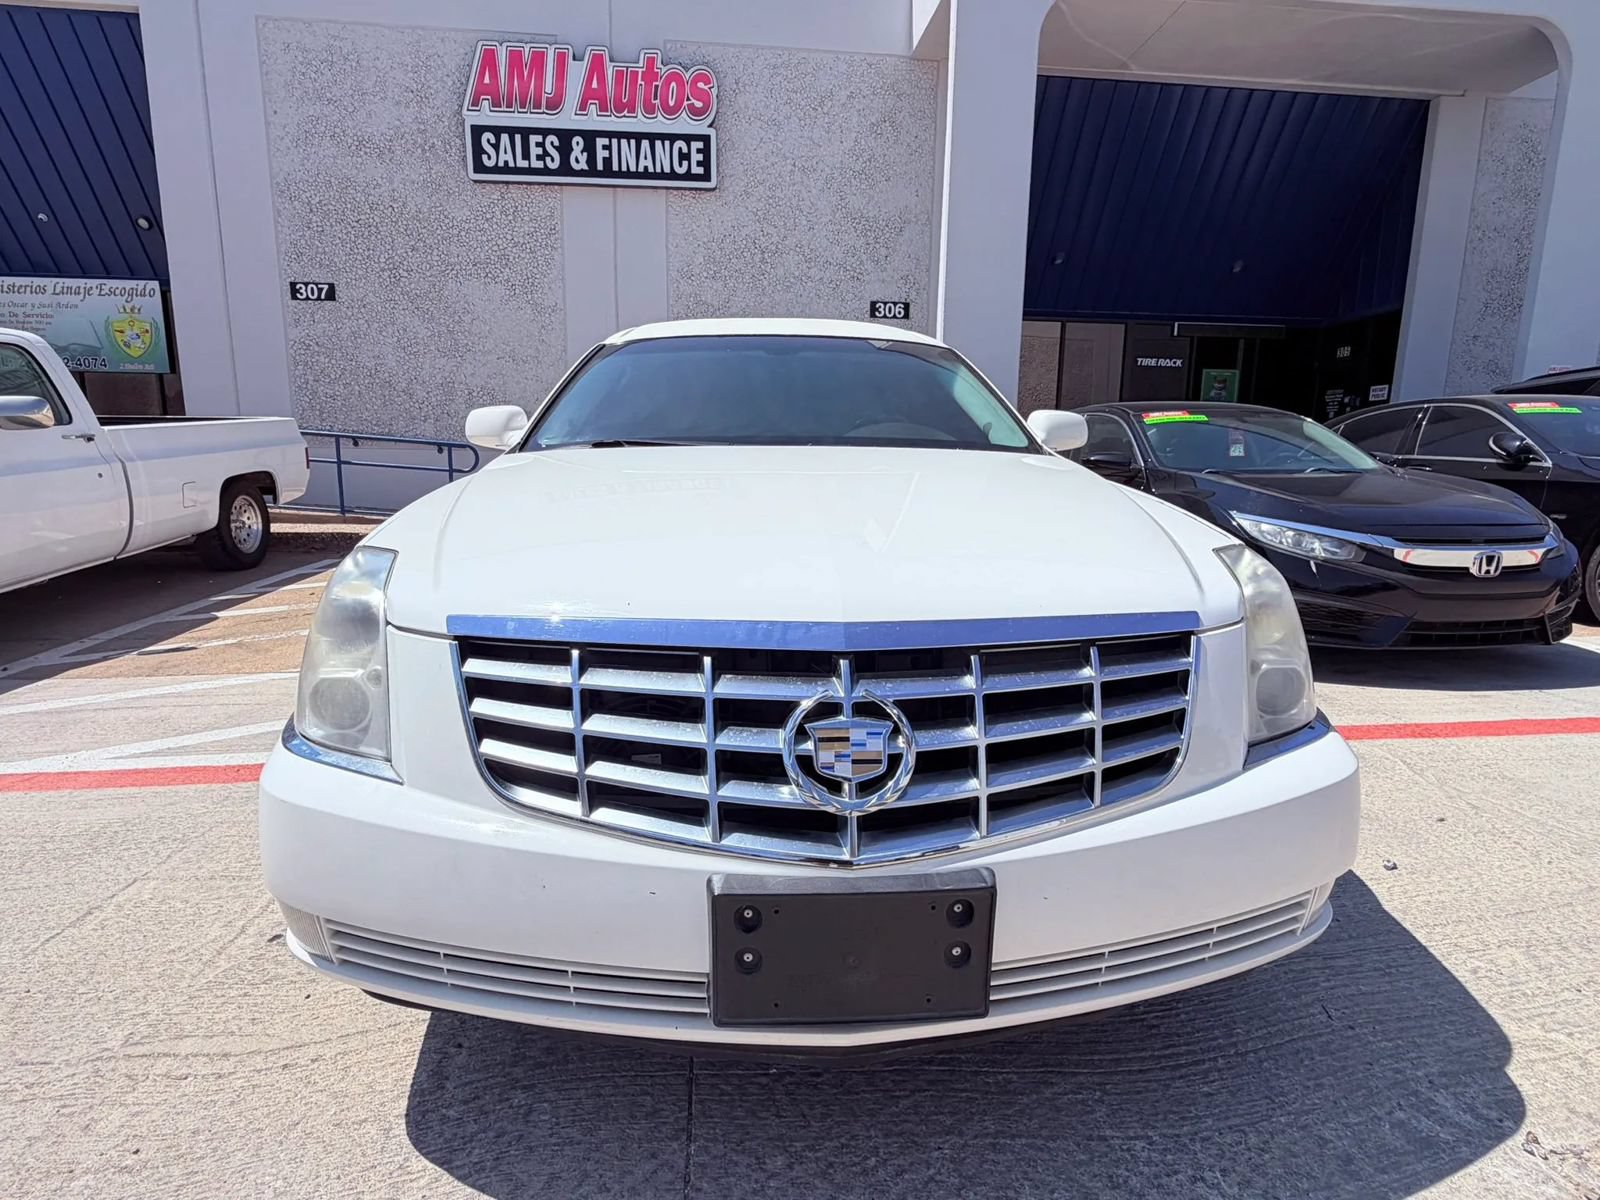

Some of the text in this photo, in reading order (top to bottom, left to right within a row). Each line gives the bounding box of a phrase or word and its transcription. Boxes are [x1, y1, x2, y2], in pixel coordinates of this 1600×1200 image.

[467, 44, 715, 120] AMJ Autos
[481, 131, 705, 175] SALES & FINANCE
[51, 281, 94, 301] Linaje
[95, 281, 156, 303] Escogido
[295, 283, 329, 300] 307
[874, 302, 905, 318] 306
[1136, 357, 1183, 368] TIRE RACK
